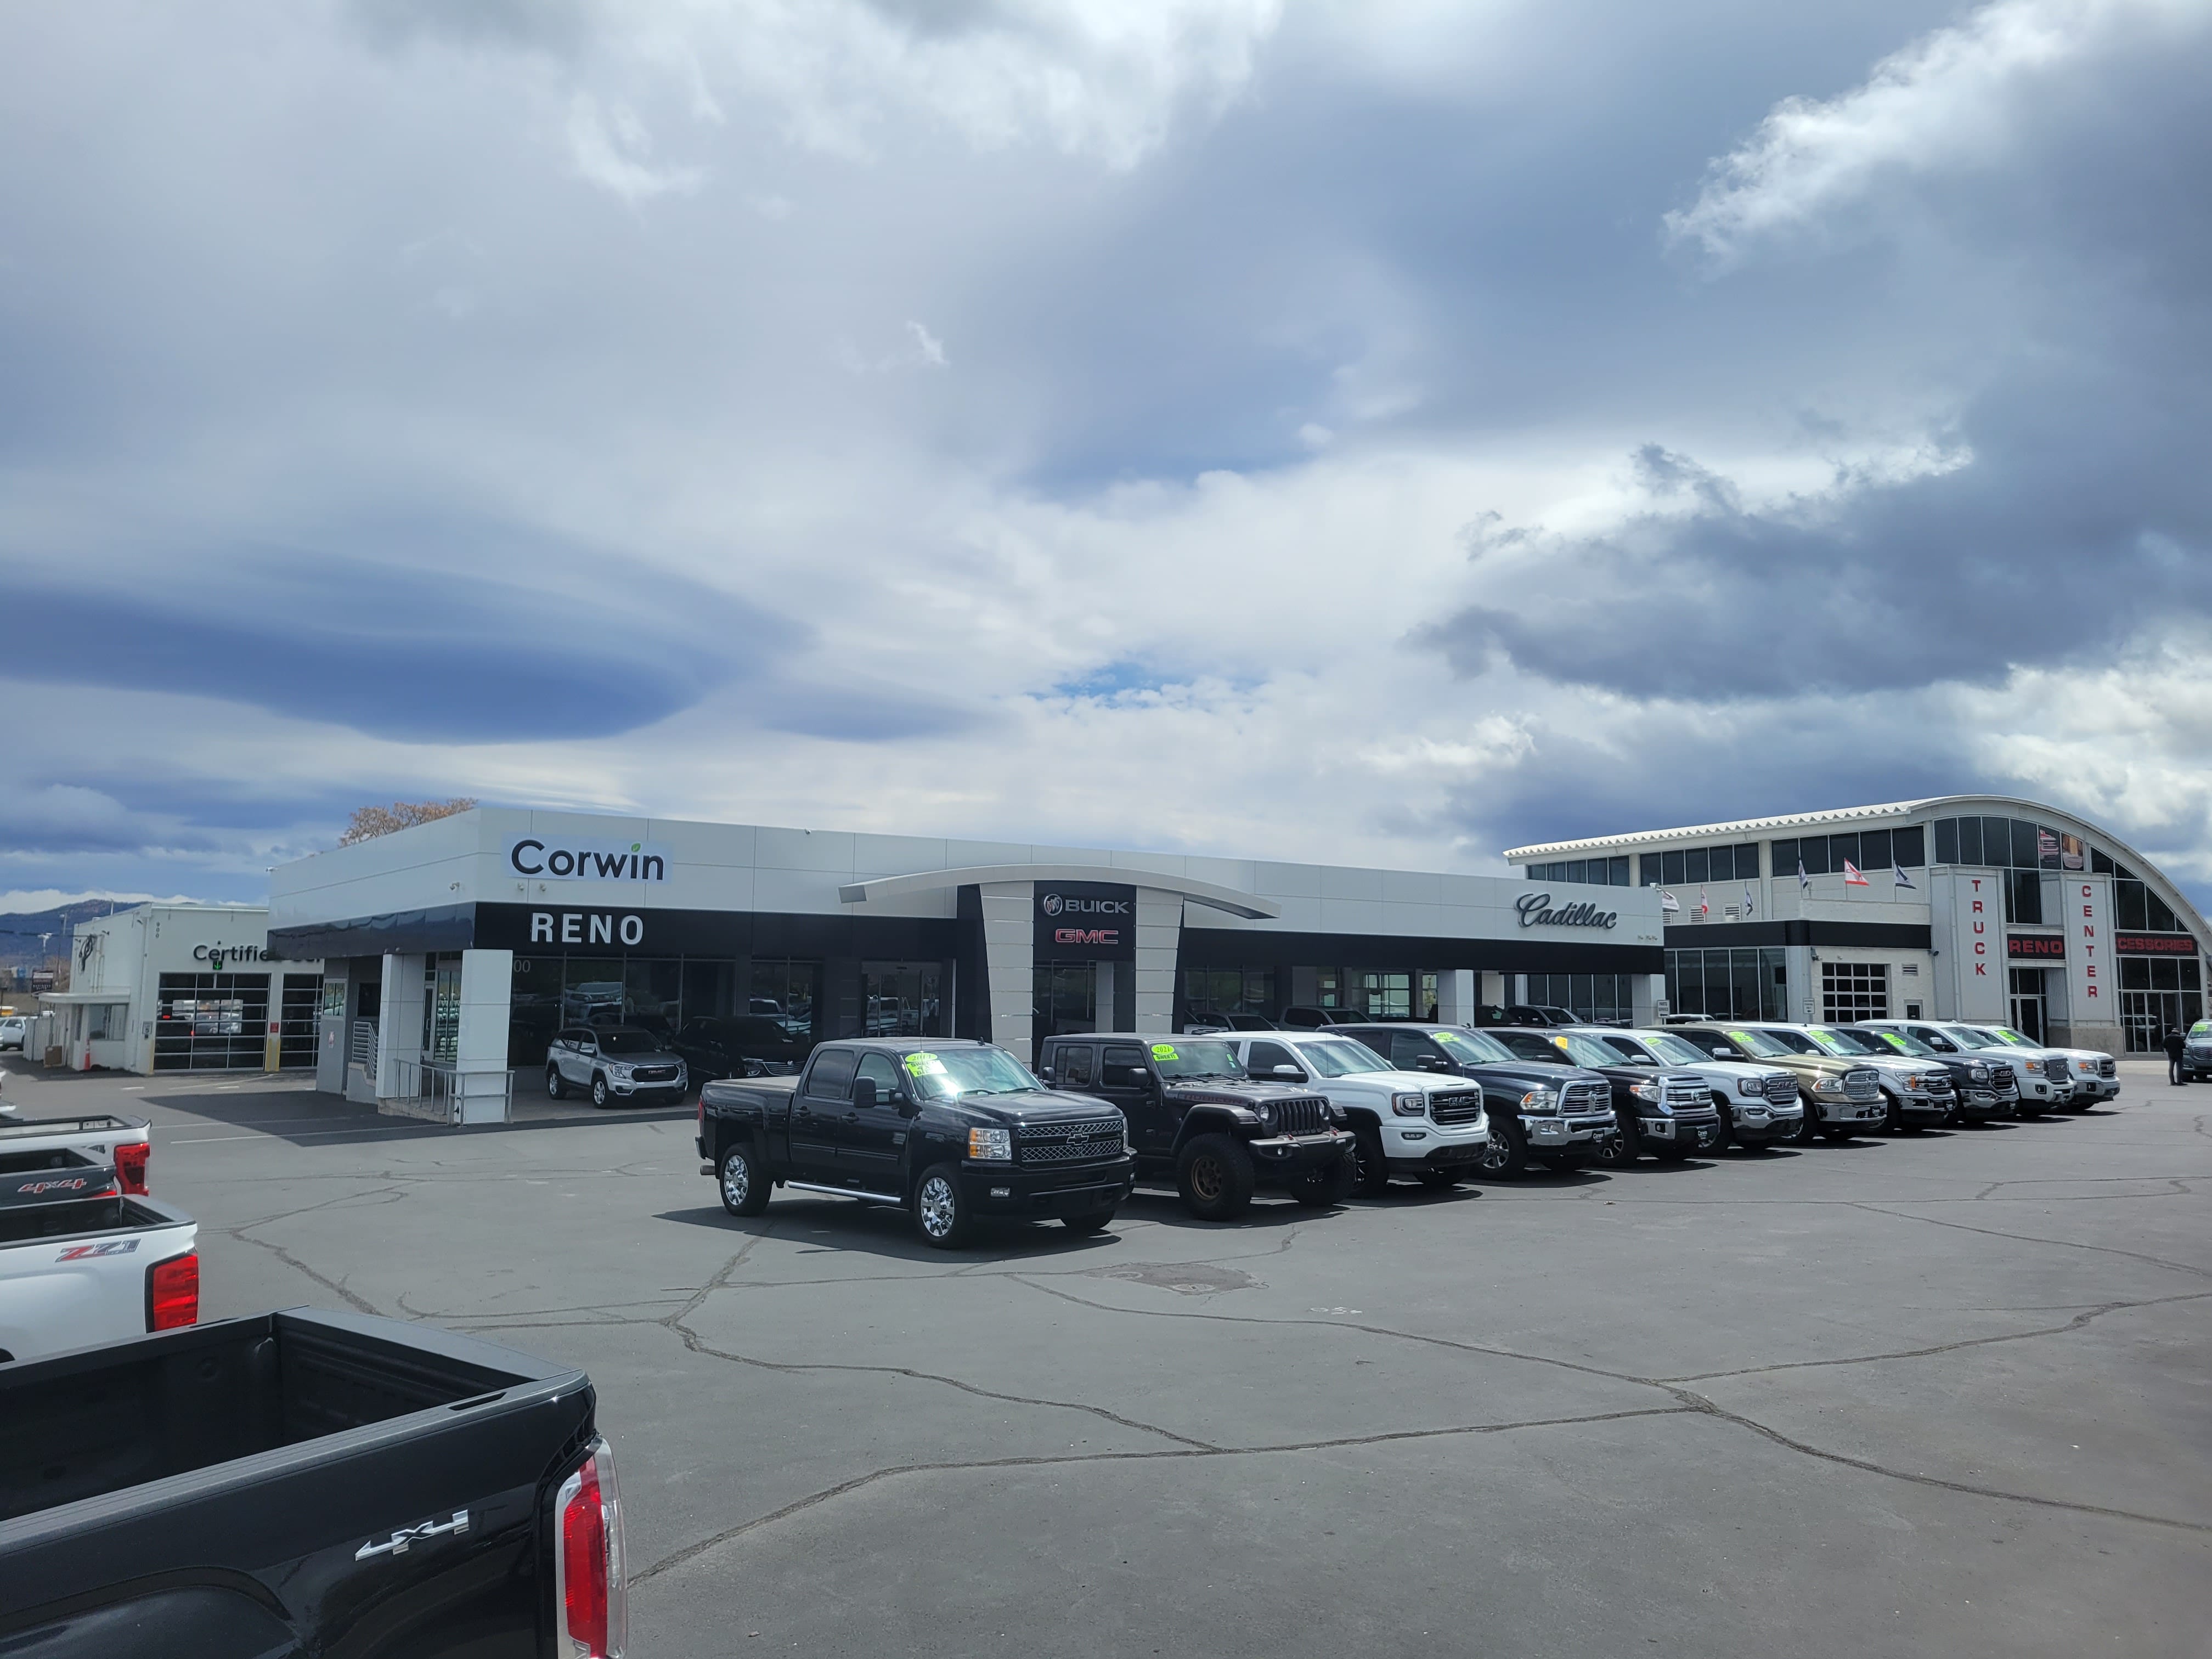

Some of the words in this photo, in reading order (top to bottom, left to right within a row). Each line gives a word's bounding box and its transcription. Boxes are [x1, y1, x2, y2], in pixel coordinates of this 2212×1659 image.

[511, 839, 664, 881] Corwin
[1065, 899, 1130, 914] BUICK
[1516, 893, 1617, 929] Cadillac
[531, 912, 644, 945] RENO
[1055, 928, 1119, 944] GMC
[1971, 879, 1987, 975] TRUCK
[2008, 939, 2063, 953] RENO
[2081, 885, 2098, 998] CENTER
[2116, 937, 2193, 951] CESSORIES
[193, 944, 268, 962] Certifie
[514, 959, 531, 973] 00
[1449, 1096, 1470, 1107] GMC
[55, 1238, 141, 1263] Z71
